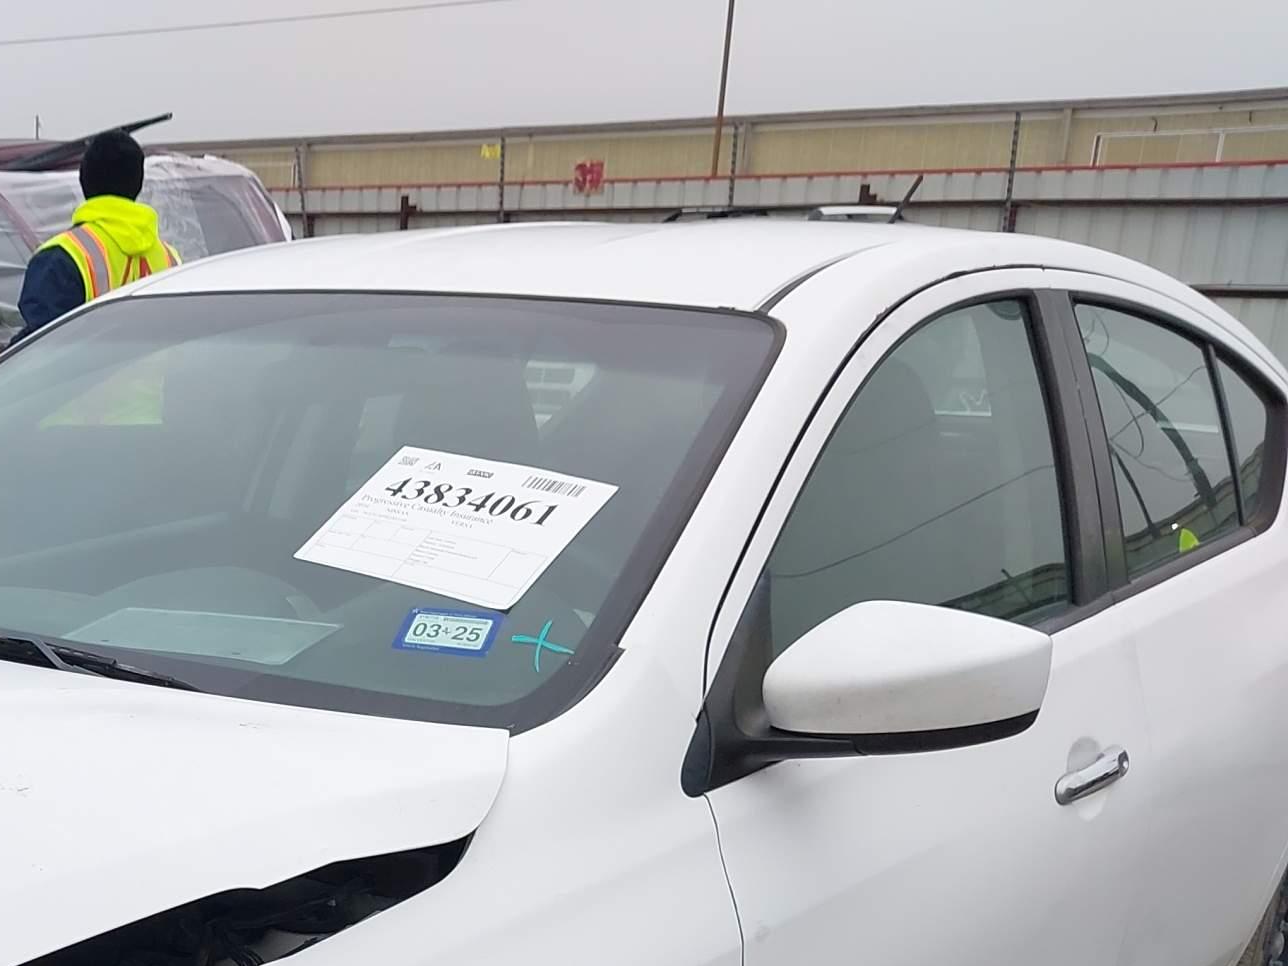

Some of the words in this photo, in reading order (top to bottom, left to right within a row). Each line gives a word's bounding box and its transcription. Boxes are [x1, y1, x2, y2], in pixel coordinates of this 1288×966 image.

[361, 493, 410, 509] Progressive
[450, 510, 494, 525] Insurance
[384, 477, 559, 527] 43834061
